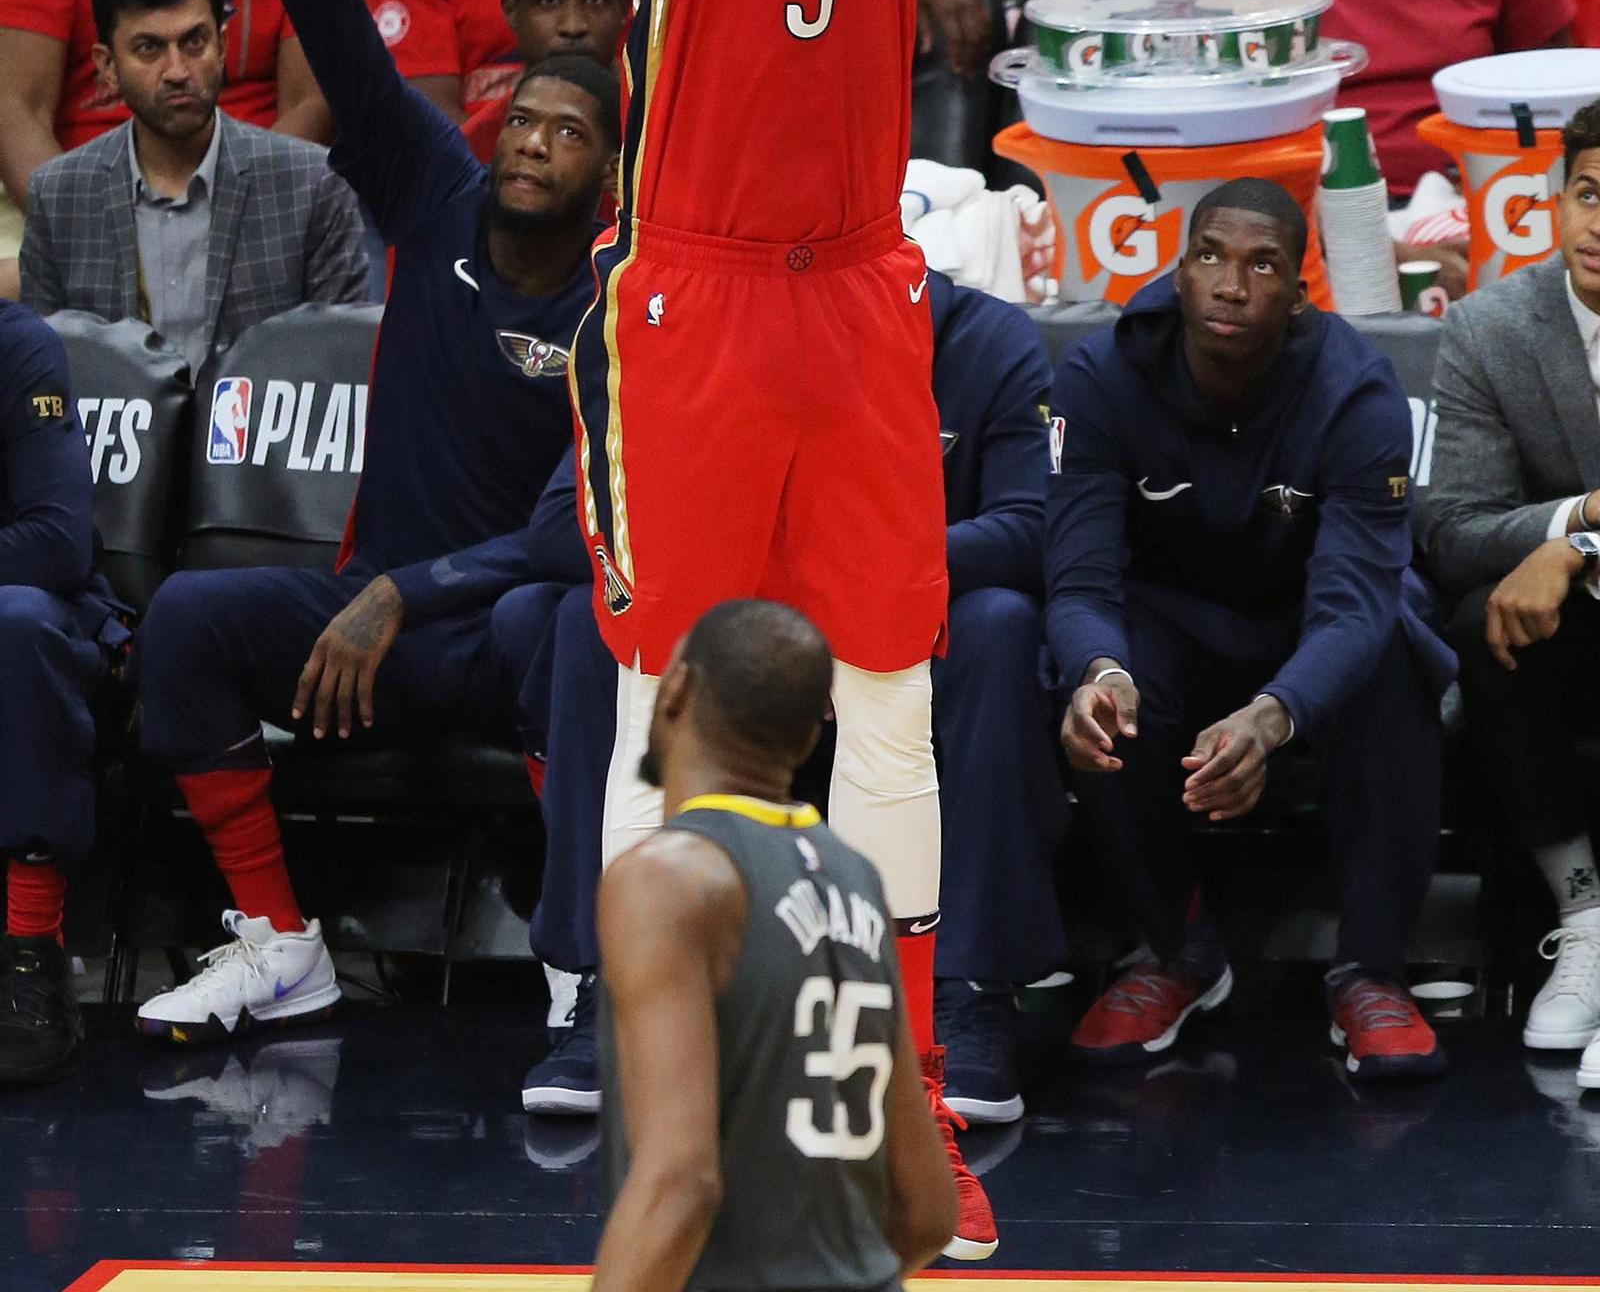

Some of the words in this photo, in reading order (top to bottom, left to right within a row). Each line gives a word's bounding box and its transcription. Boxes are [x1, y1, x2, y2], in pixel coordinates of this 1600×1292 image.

[1089, 194, 1159, 277] G
[1482, 173, 1554, 257] G
[32, 395, 64, 418] TB
[785, 975, 894, 1161] 35
